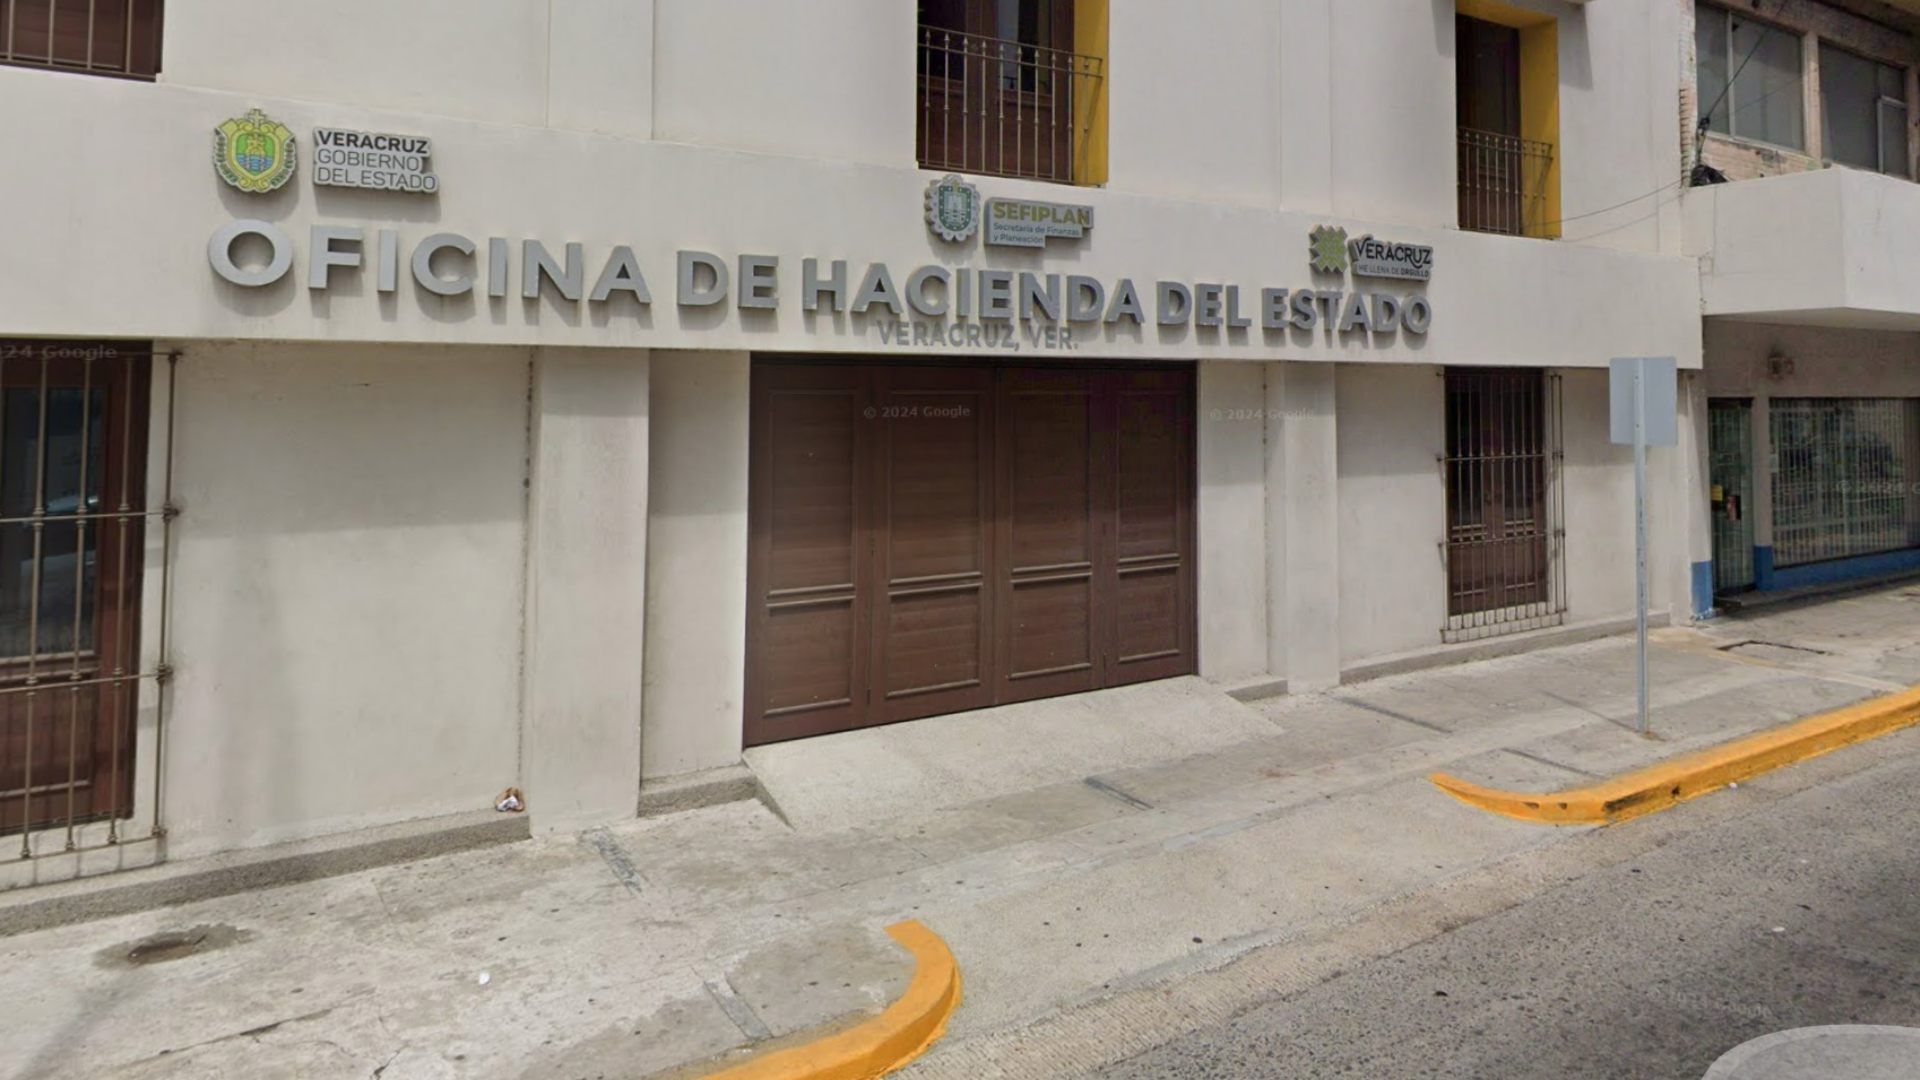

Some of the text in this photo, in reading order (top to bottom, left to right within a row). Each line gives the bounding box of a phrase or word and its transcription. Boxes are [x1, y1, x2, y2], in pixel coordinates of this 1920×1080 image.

[318, 130, 428, 154] VERACRUZ
[318, 148, 420, 172] GOBIERNO
[317, 166, 436, 190] DEL ESTADO
[992, 201, 1090, 226] SEFIPLAN
[1035, 224, 1045, 233] de
[1047, 226, 1080, 236] Finanzas
[1355, 236, 1431, 269] VERACRUZ
[208, 219, 1432, 334] OFICINA DE HACIENDA DEL ESTADO
[876, 319, 1079, 351] VERACRUZ, VER.
